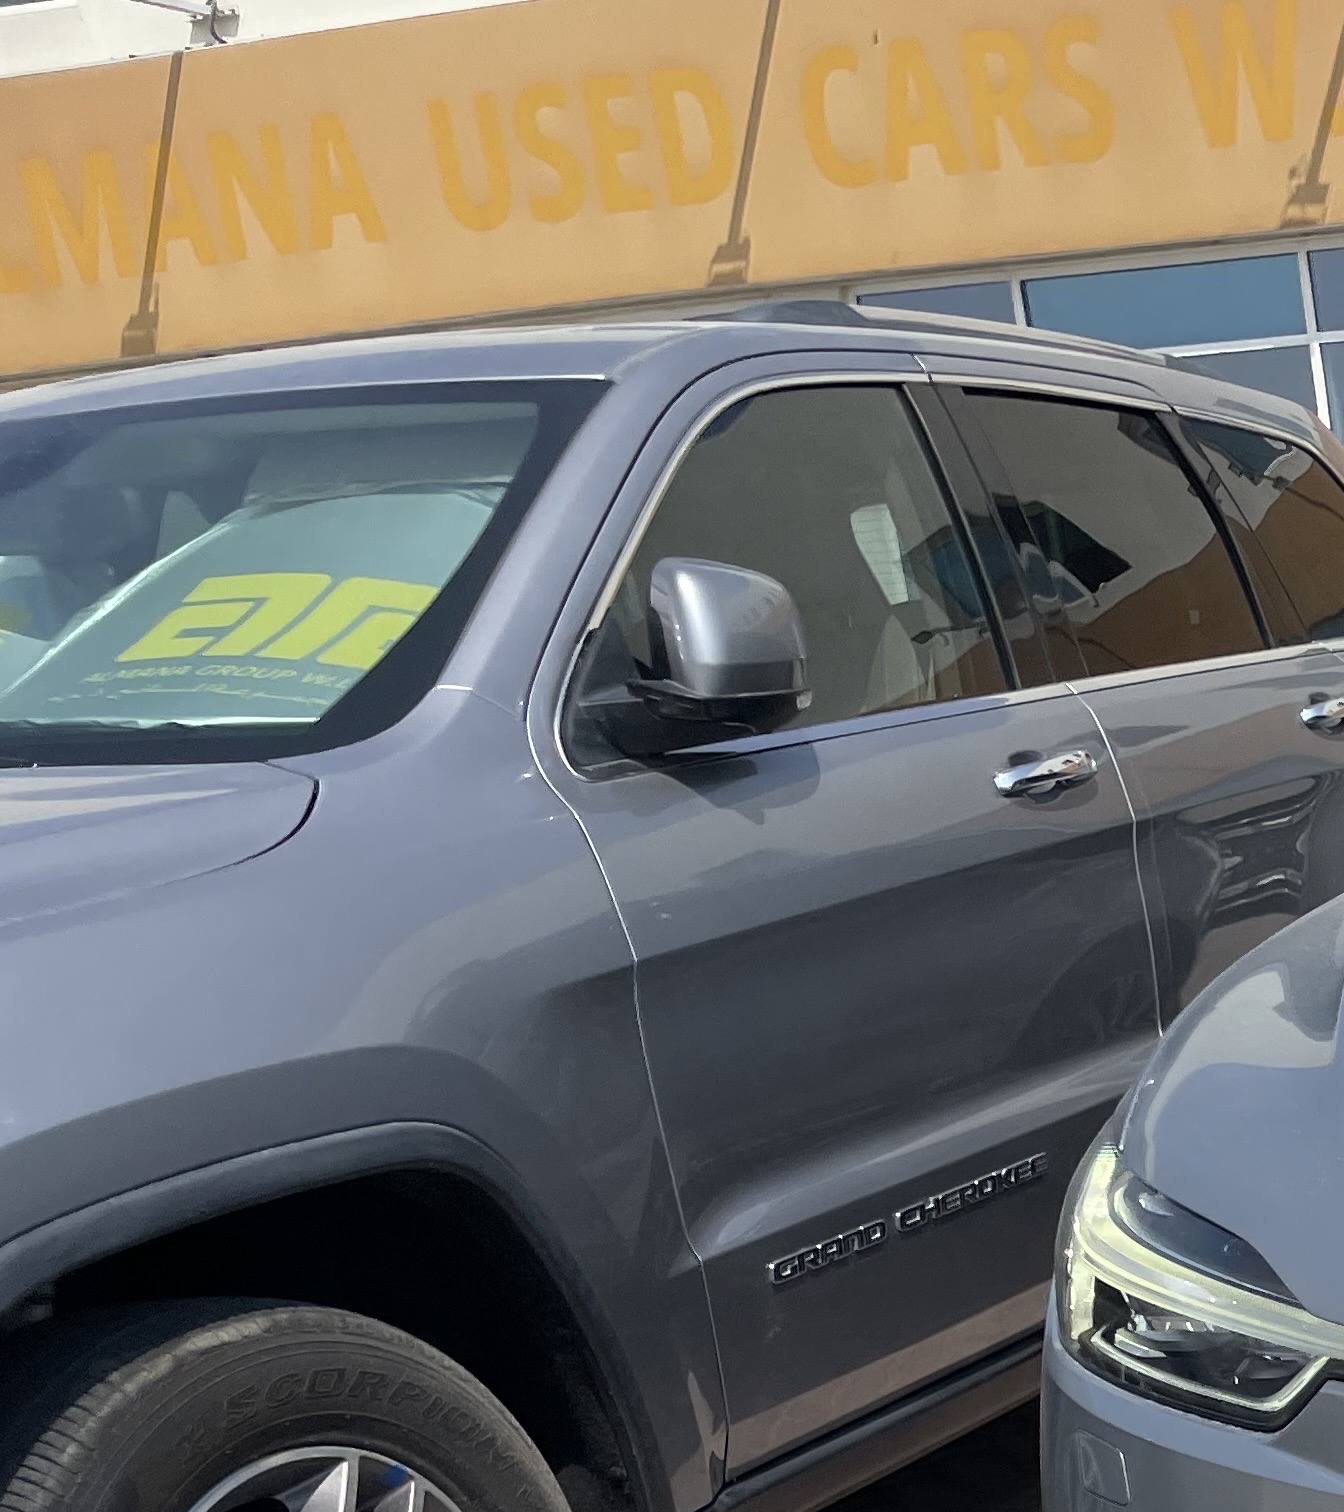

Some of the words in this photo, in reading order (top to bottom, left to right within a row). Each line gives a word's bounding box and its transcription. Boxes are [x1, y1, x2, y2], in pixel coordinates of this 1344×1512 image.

[427, 67, 739, 232] USED
[803, 15, 1117, 189] CARS
[768, 1218, 888, 1285] GRAND
[894, 1151, 1048, 1232] CHEROKEE
